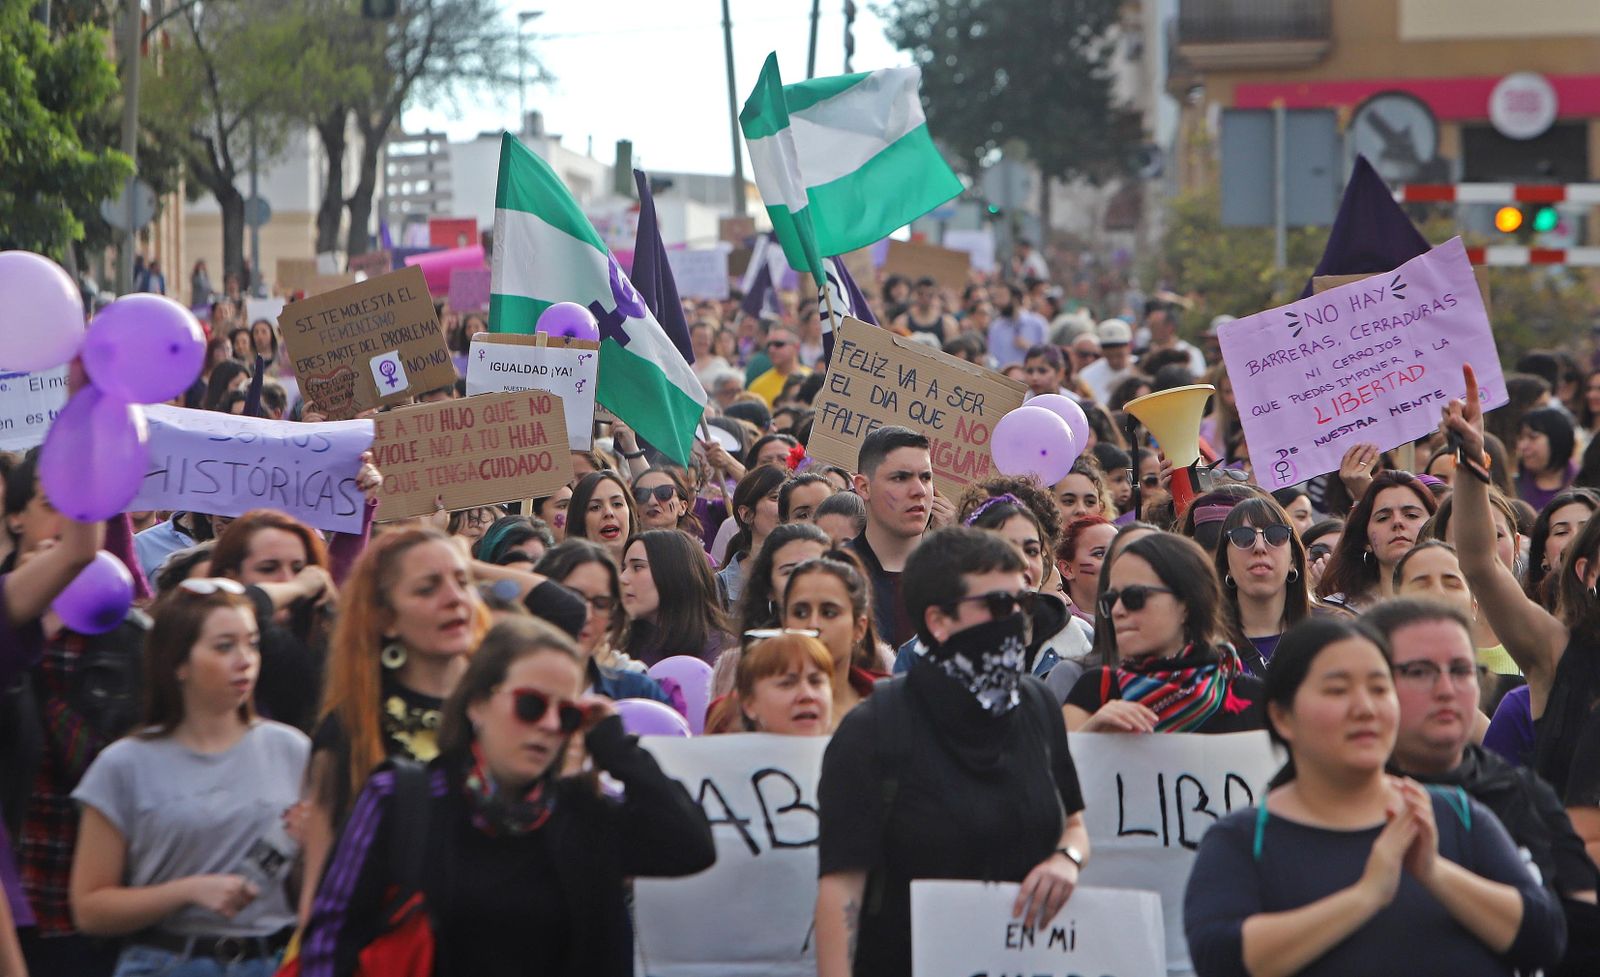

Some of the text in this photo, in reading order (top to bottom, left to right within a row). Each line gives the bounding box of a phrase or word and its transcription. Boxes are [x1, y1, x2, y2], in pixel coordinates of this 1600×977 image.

[295, 287, 417, 334] SI TE MOLESTA EL
[318, 311, 396, 345] FEMINISMO
[1304, 287, 1385, 327] NO HAY
[296, 319, 440, 373] ERES PARTE DEL PROBLEMA
[1245, 293, 1458, 377] BARRERAS, CERRADURAS
[1305, 335, 1402, 380] NI CERROJOS
[489, 361, 573, 378] IGUALDAD ¡YA!
[898, 364, 917, 392] VA
[925, 379, 938, 400] A
[946, 386, 985, 416] SER
[1251, 338, 1450, 417] QUE PUEDAS IMPONER A LA
[395, 418, 407, 438] A
[413, 413, 434, 434] TU
[440, 407, 475, 433] HIJO
[482, 400, 519, 425] QUE
[529, 395, 552, 416] NO
[830, 373, 851, 397] EL
[908, 401, 946, 430] QUE
[954, 416, 989, 446] NO
[1314, 364, 1425, 425] LIBERTAD
[26, 413, 44, 425] es
[429, 435, 453, 459] NO
[462, 433, 473, 454] A
[477, 429, 500, 450] TU
[508, 421, 549, 449] HIJA
[1276, 389, 1446, 460] DE NUESTRA MENTE
[382, 451, 559, 495] QUE TENGA CUIDADO.
[1005, 922, 1035, 952] EN
